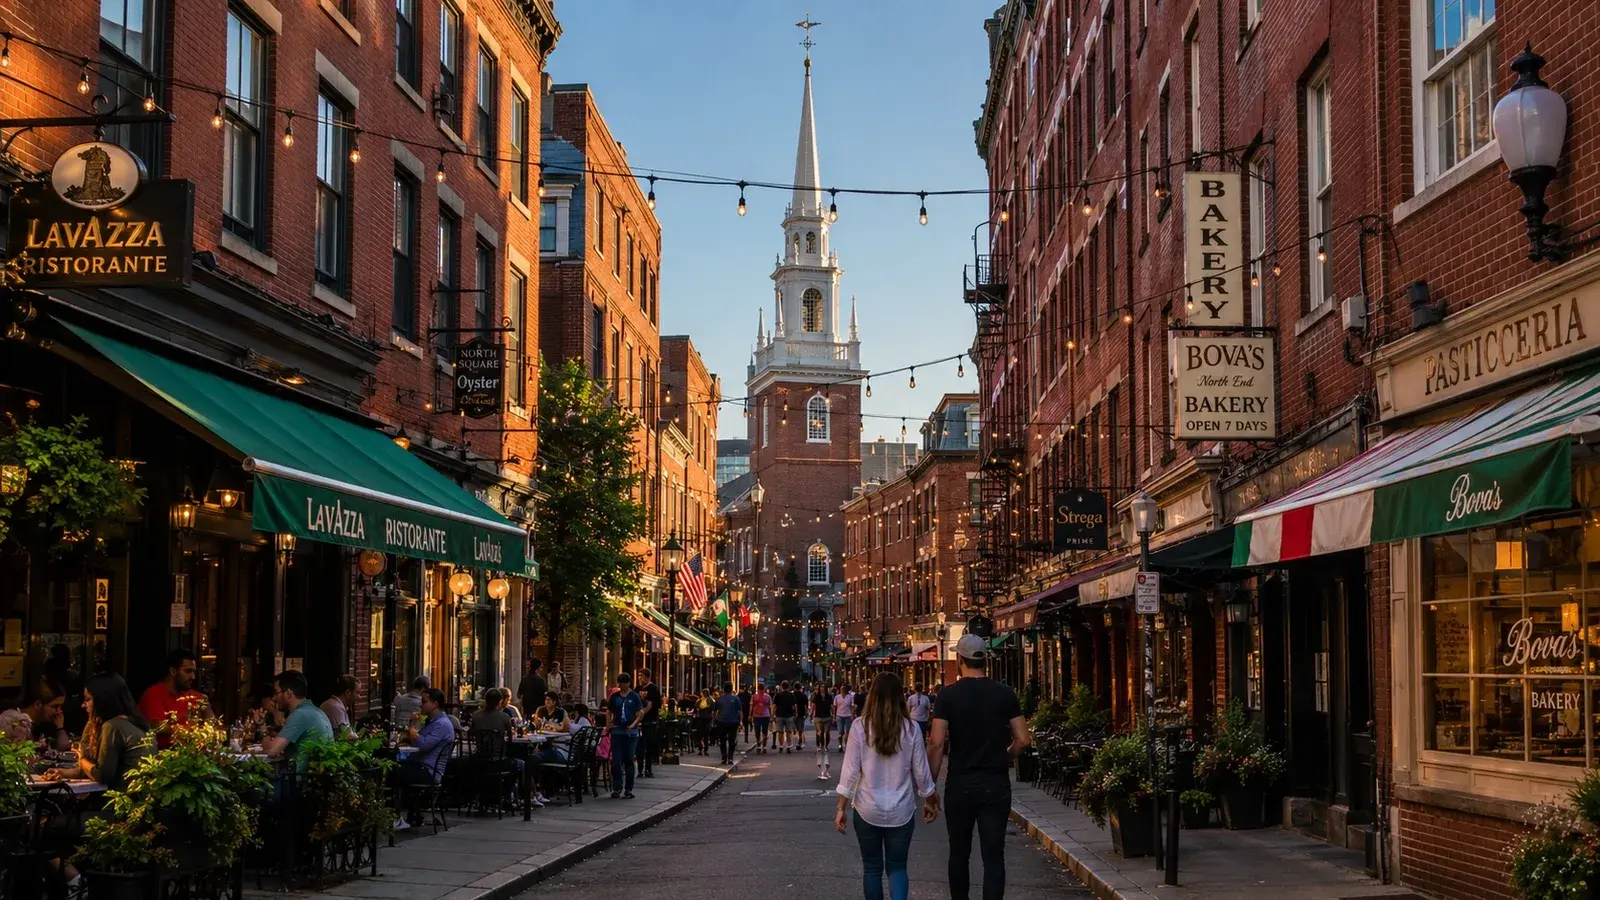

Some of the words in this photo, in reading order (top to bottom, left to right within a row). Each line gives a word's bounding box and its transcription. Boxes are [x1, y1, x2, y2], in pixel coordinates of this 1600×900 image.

[1199, 180, 1229, 319] BAKERY
[24, 255, 168, 275] RISTORANTE
[460, 348, 497, 359] NORTH
[1423, 297, 1587, 396] PASTICCERIA
[458, 359, 500, 370] SQUARE
[1186, 344, 1266, 371] BOVA'S
[457, 374, 500, 393] Oyster
[1196, 375, 1229, 388] North
[1232, 375, 1255, 388] End
[1184, 396, 1269, 414] BAKERY
[1186, 420, 1221, 431] OPEN
[1225, 420, 1233, 431] 7
[1235, 420, 1268, 432] DAYS
[1446, 472, 1504, 522] Bova's
[1056, 505, 1104, 529] Strega
[385, 518, 447, 554] RISTORANTE
[1066, 537, 1095, 545] PRIME
[1502, 617, 1586, 668] Bova's
[1531, 691, 1582, 711] BAKERY
